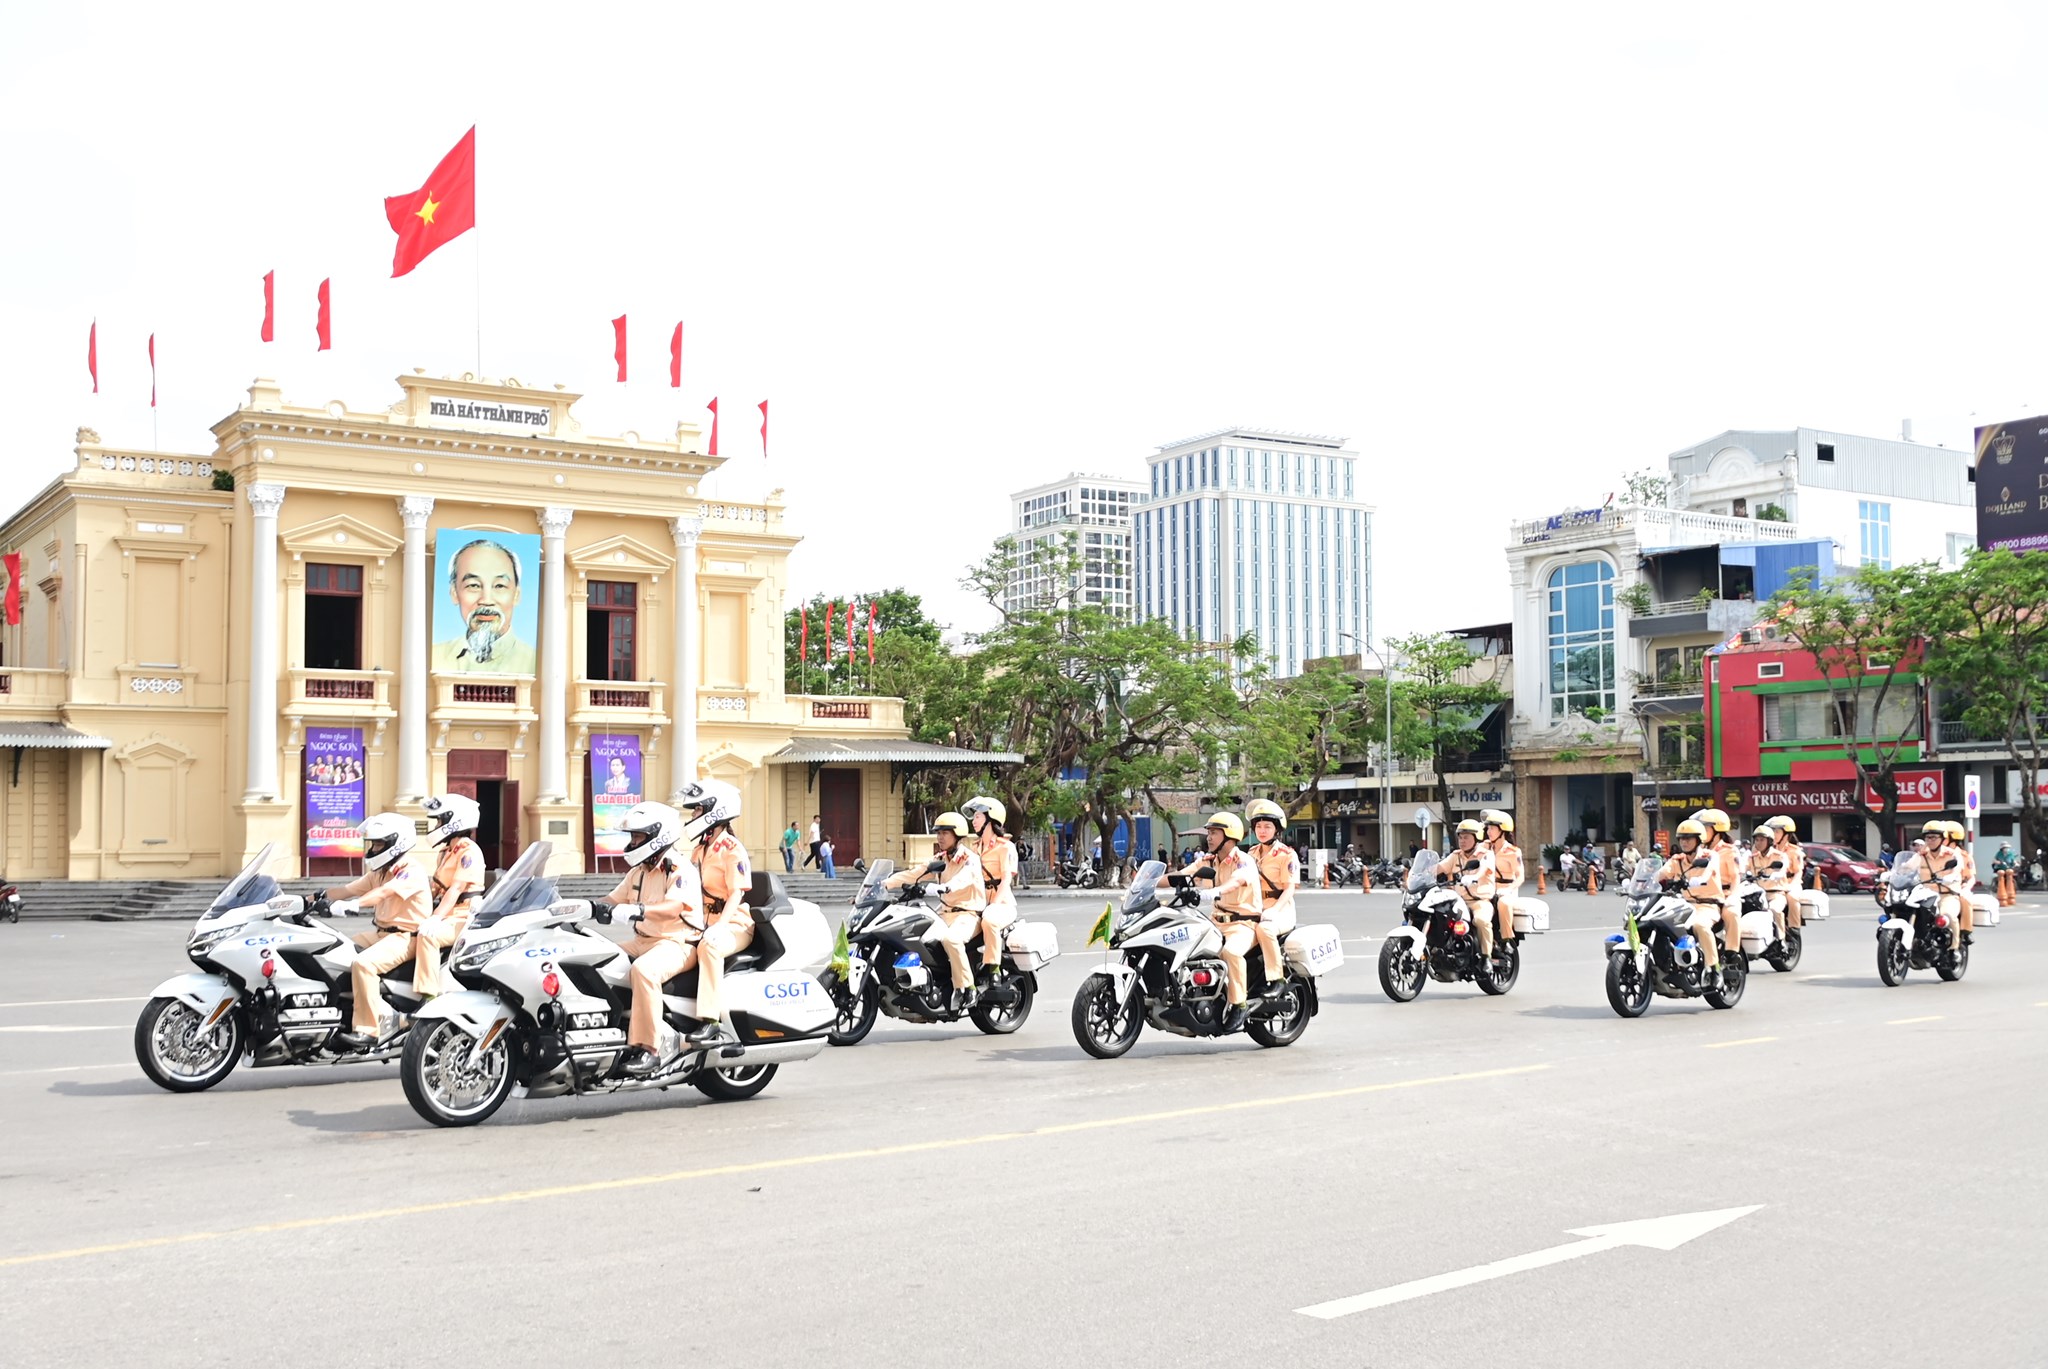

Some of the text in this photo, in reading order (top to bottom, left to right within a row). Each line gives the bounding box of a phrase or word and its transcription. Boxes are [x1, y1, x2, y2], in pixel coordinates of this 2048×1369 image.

[430, 400, 550, 426] NHÀ HÁT THÀNH PHỐ
[1985, 501, 2027, 514] DOJILAND
[1752, 783, 1789, 791] COFFEE
[1752, 794, 1797, 806] TRUNG
[1800, 789, 1851, 805] NGUYÊ
[703, 806, 728, 825] CSGT
[441, 818, 464, 835] CSGT
[389, 837, 406, 858] CSG
